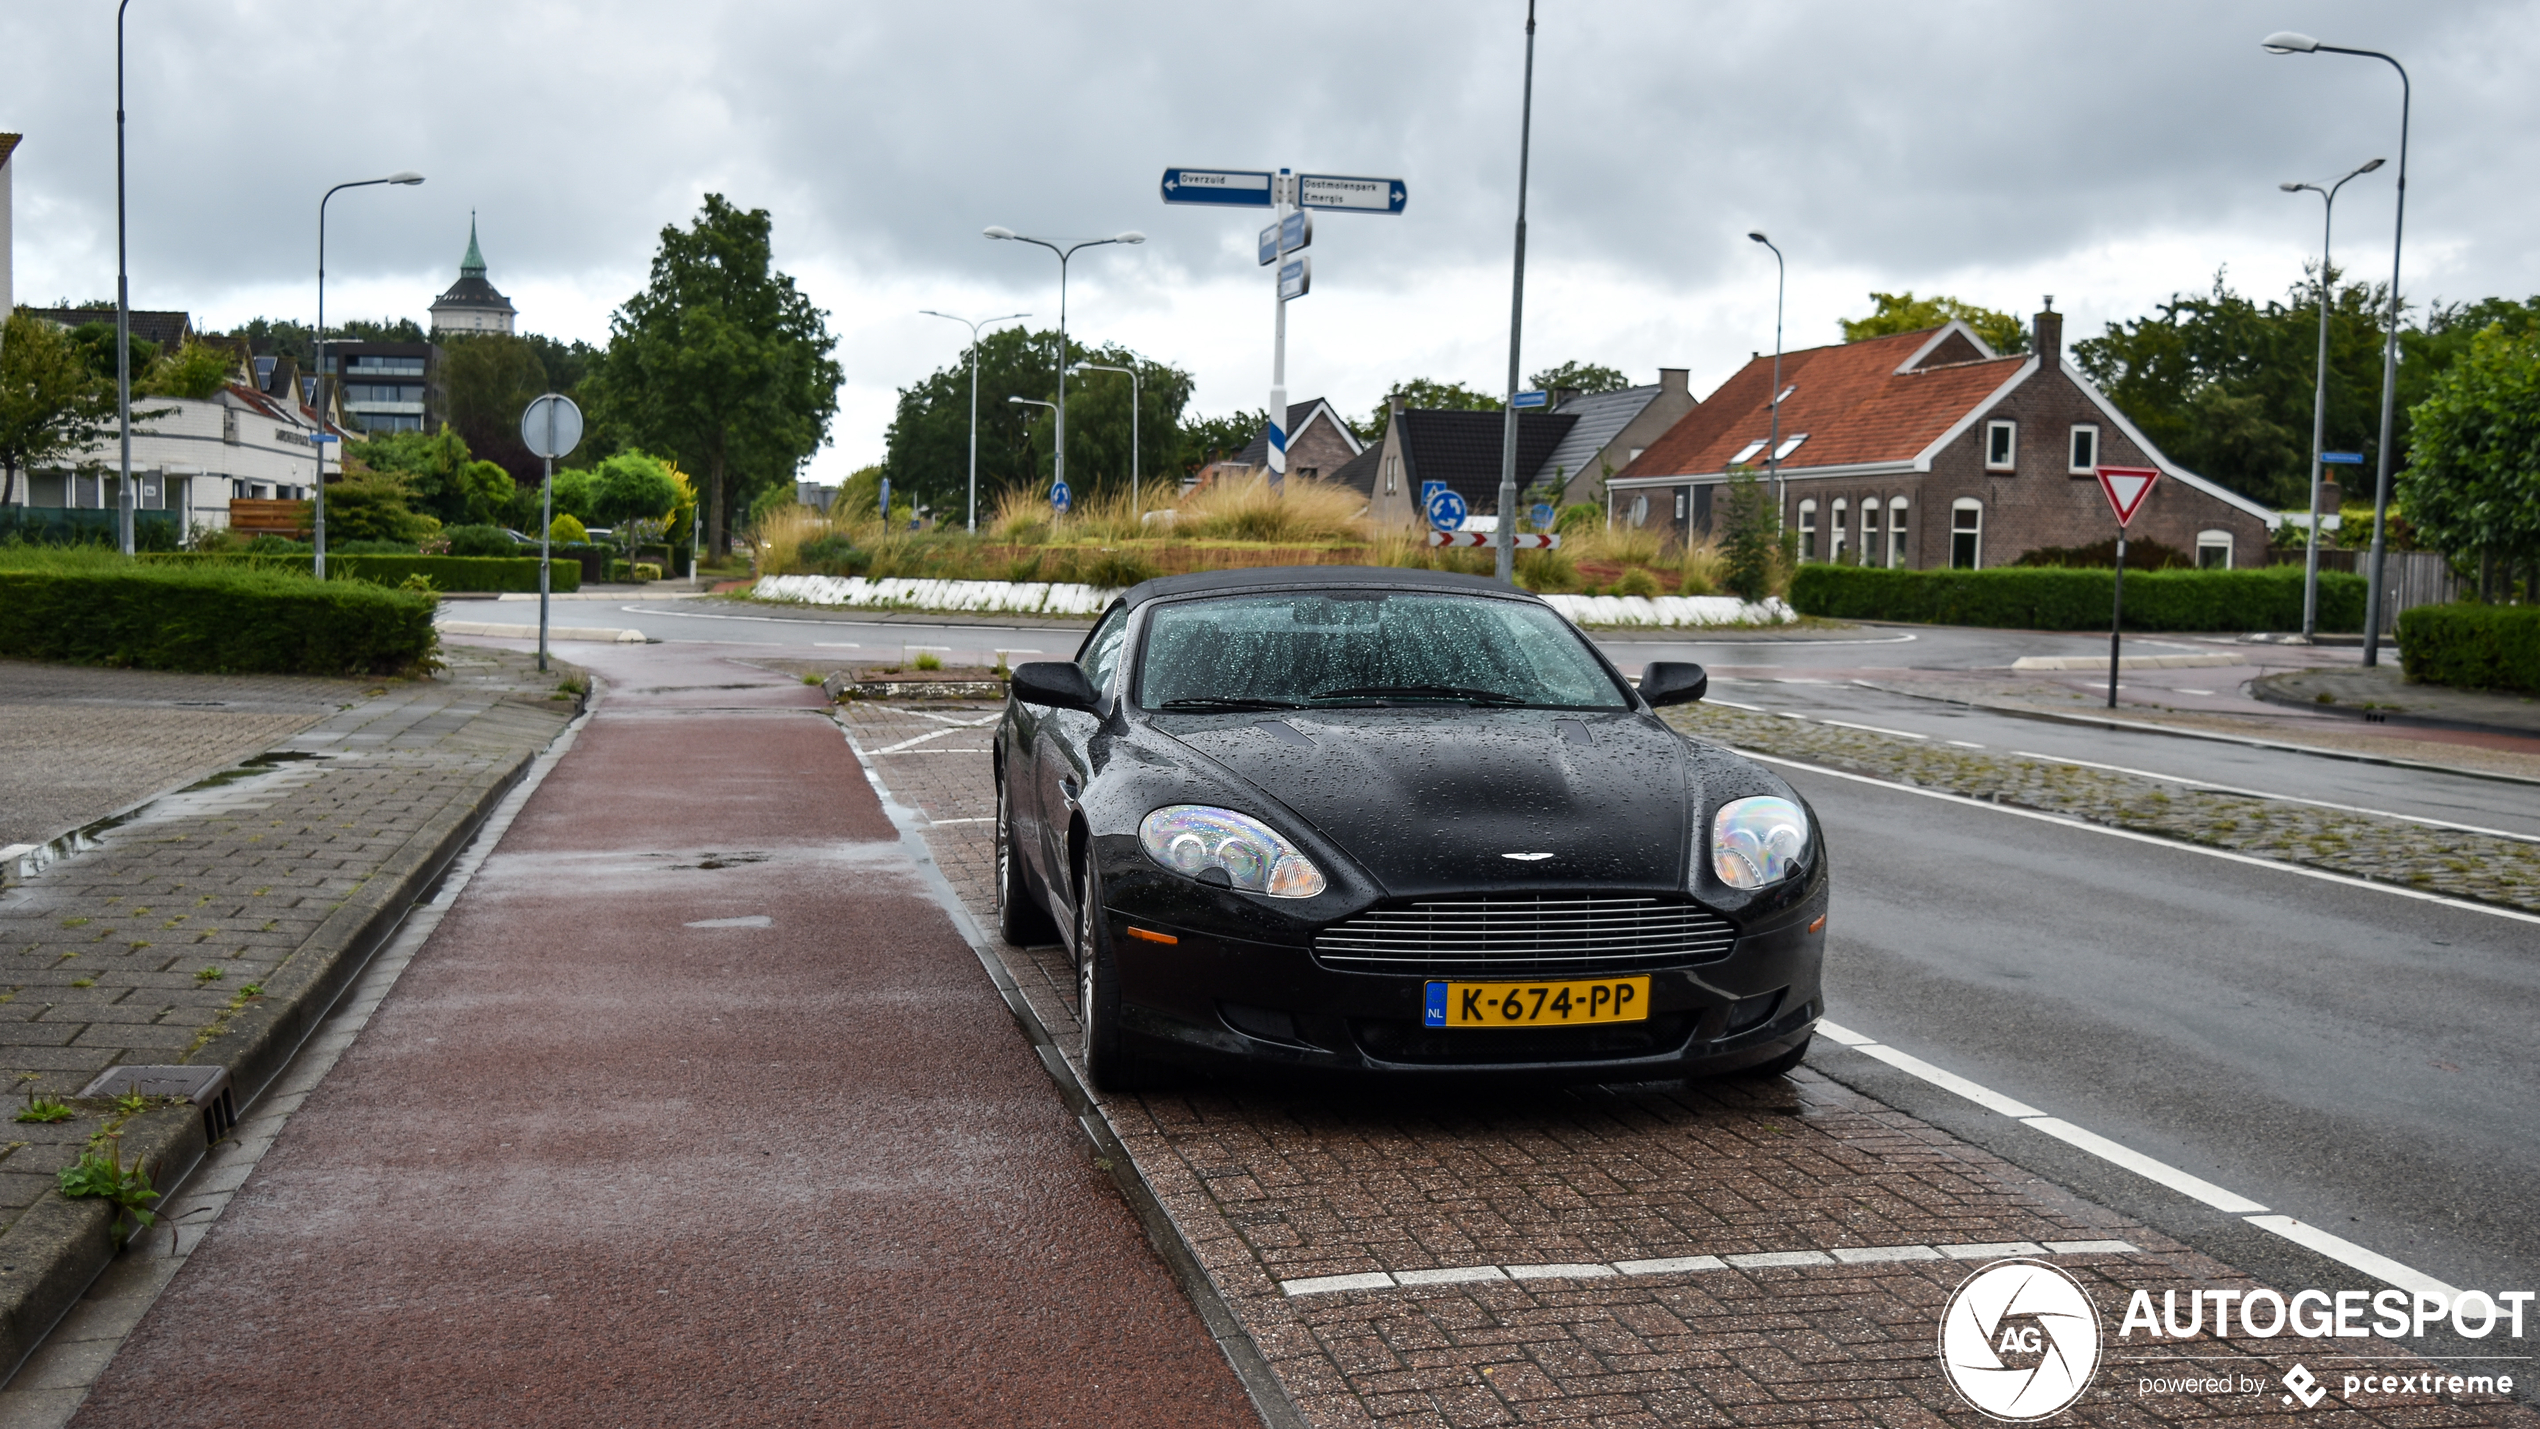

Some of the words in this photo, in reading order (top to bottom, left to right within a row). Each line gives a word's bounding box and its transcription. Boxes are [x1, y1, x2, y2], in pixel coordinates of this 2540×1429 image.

[1181, 174, 1226, 185] Overzuid
[1303, 180, 1377, 192] Oostmolenpark
[1303, 193, 1344, 205] Emergis
[1461, 983, 1635, 1021] K-674-PP
[1428, 1008, 1443, 1019] NL
